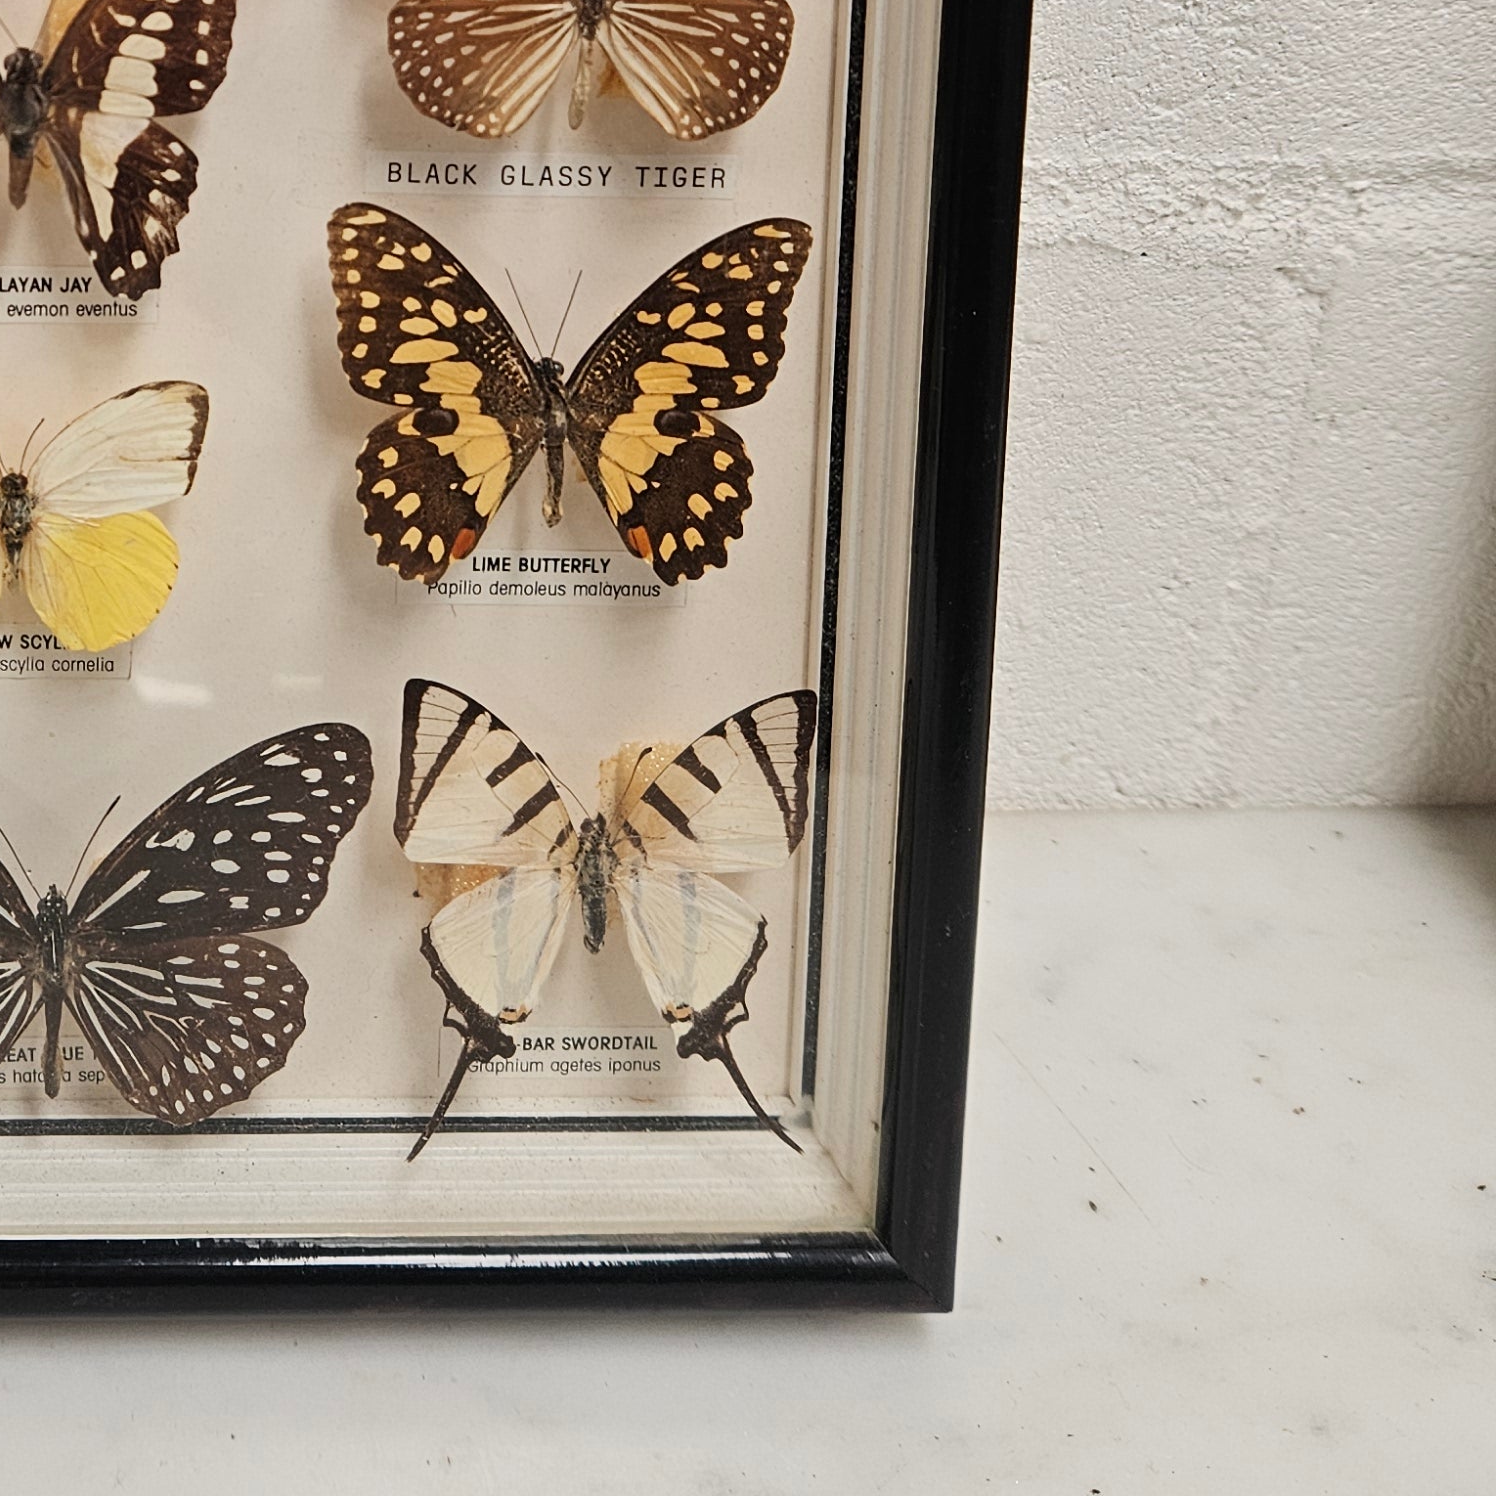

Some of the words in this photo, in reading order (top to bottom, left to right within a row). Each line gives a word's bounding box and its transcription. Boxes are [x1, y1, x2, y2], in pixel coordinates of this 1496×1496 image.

[388, 162, 478, 185] BLACK
[501, 164, 613, 187] GLASSY
[635, 166, 727, 189] TIGER
[60, 277, 92, 293] JAY
[7, 304, 69, 317] evemon
[76, 301, 138, 317] eventus
[472, 557, 511, 573] LIME
[518, 557, 611, 574] BUTTERFLY
[428, 581, 482, 597] Papilio
[489, 581, 566, 596] demoleus
[573, 581, 661, 600] malayanus
[20, 634, 67, 650] SCYL
[51, 655, 115, 672] cornelia
[562, 1036, 658, 1051] SWORDTAIL
[468, 1058, 544, 1075] Graphium
[550, 1058, 602, 1074] agetes
[608, 1057, 661, 1074] iponus
